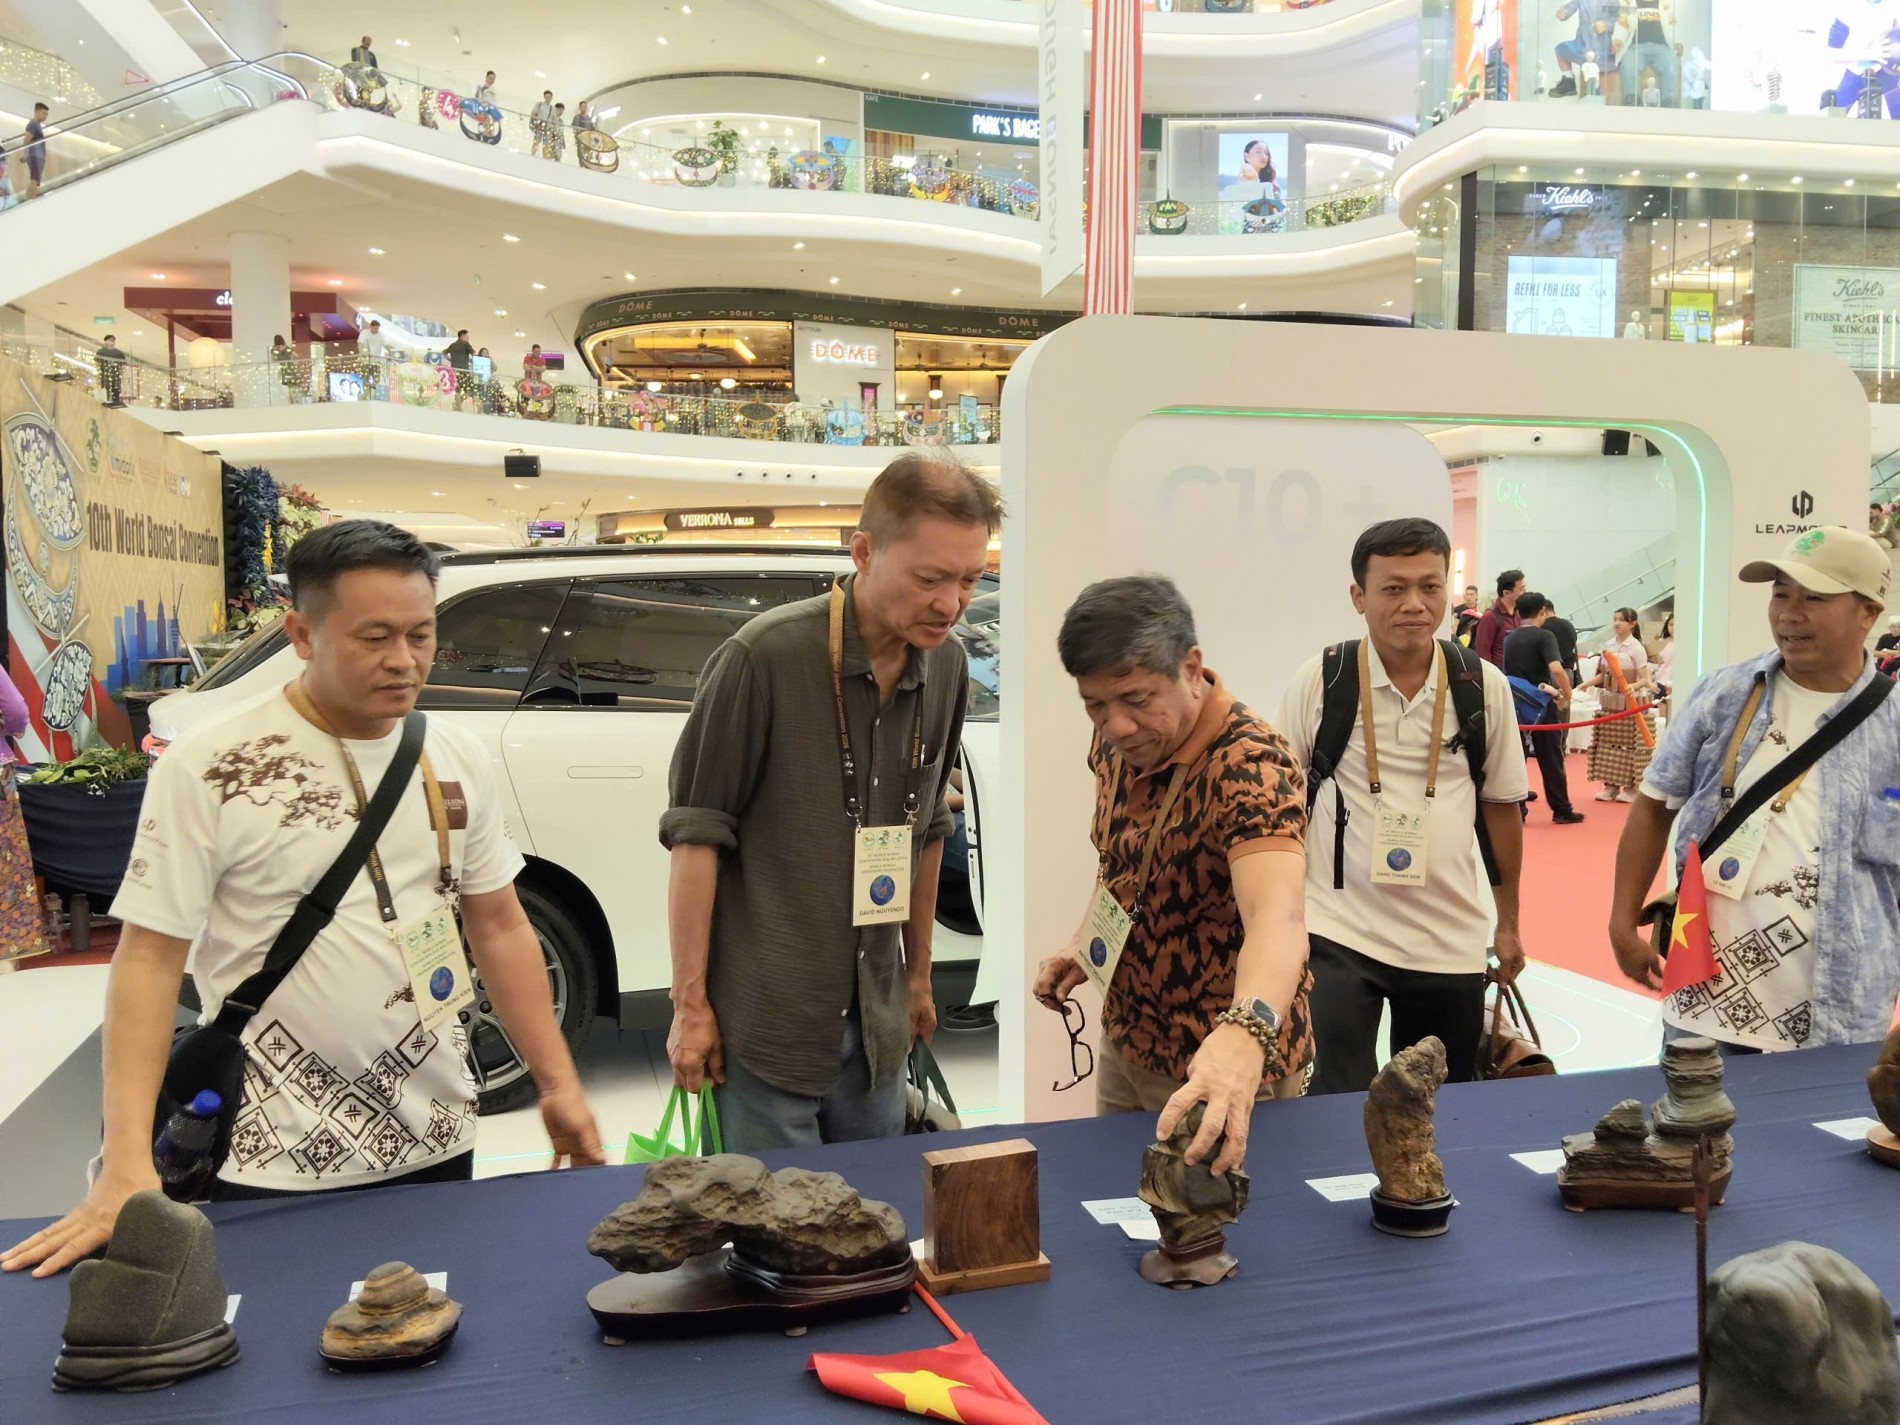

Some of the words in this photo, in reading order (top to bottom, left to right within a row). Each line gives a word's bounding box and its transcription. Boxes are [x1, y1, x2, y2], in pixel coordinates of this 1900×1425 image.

[972, 114, 1011, 137] PARK'S
[1542, 186, 1594, 205] Kiehl's
[1543, 283, 1558, 297] FOR
[1560, 283, 1581, 297] LESS
[1832, 278, 1885, 297] Kiehl's
[618, 300, 653, 313] DÔME
[813, 313, 834, 322] DÔME
[999, 316, 1040, 327] DÔME
[1804, 312, 1841, 323] FINEST
[889, 321, 909, 329] DÔME
[815, 342, 877, 362] DÔME
[680, 512, 732, 527] VERRONA
[87, 501, 112, 552] 10th
[114, 507, 145, 557] World
[147, 515, 177, 561] Bonsai
[179, 523, 219, 567] Convention
[1756, 524, 1847, 534] LEAPM
[837, 696, 847, 733] Convention
[859, 908, 875, 916] DAVID
